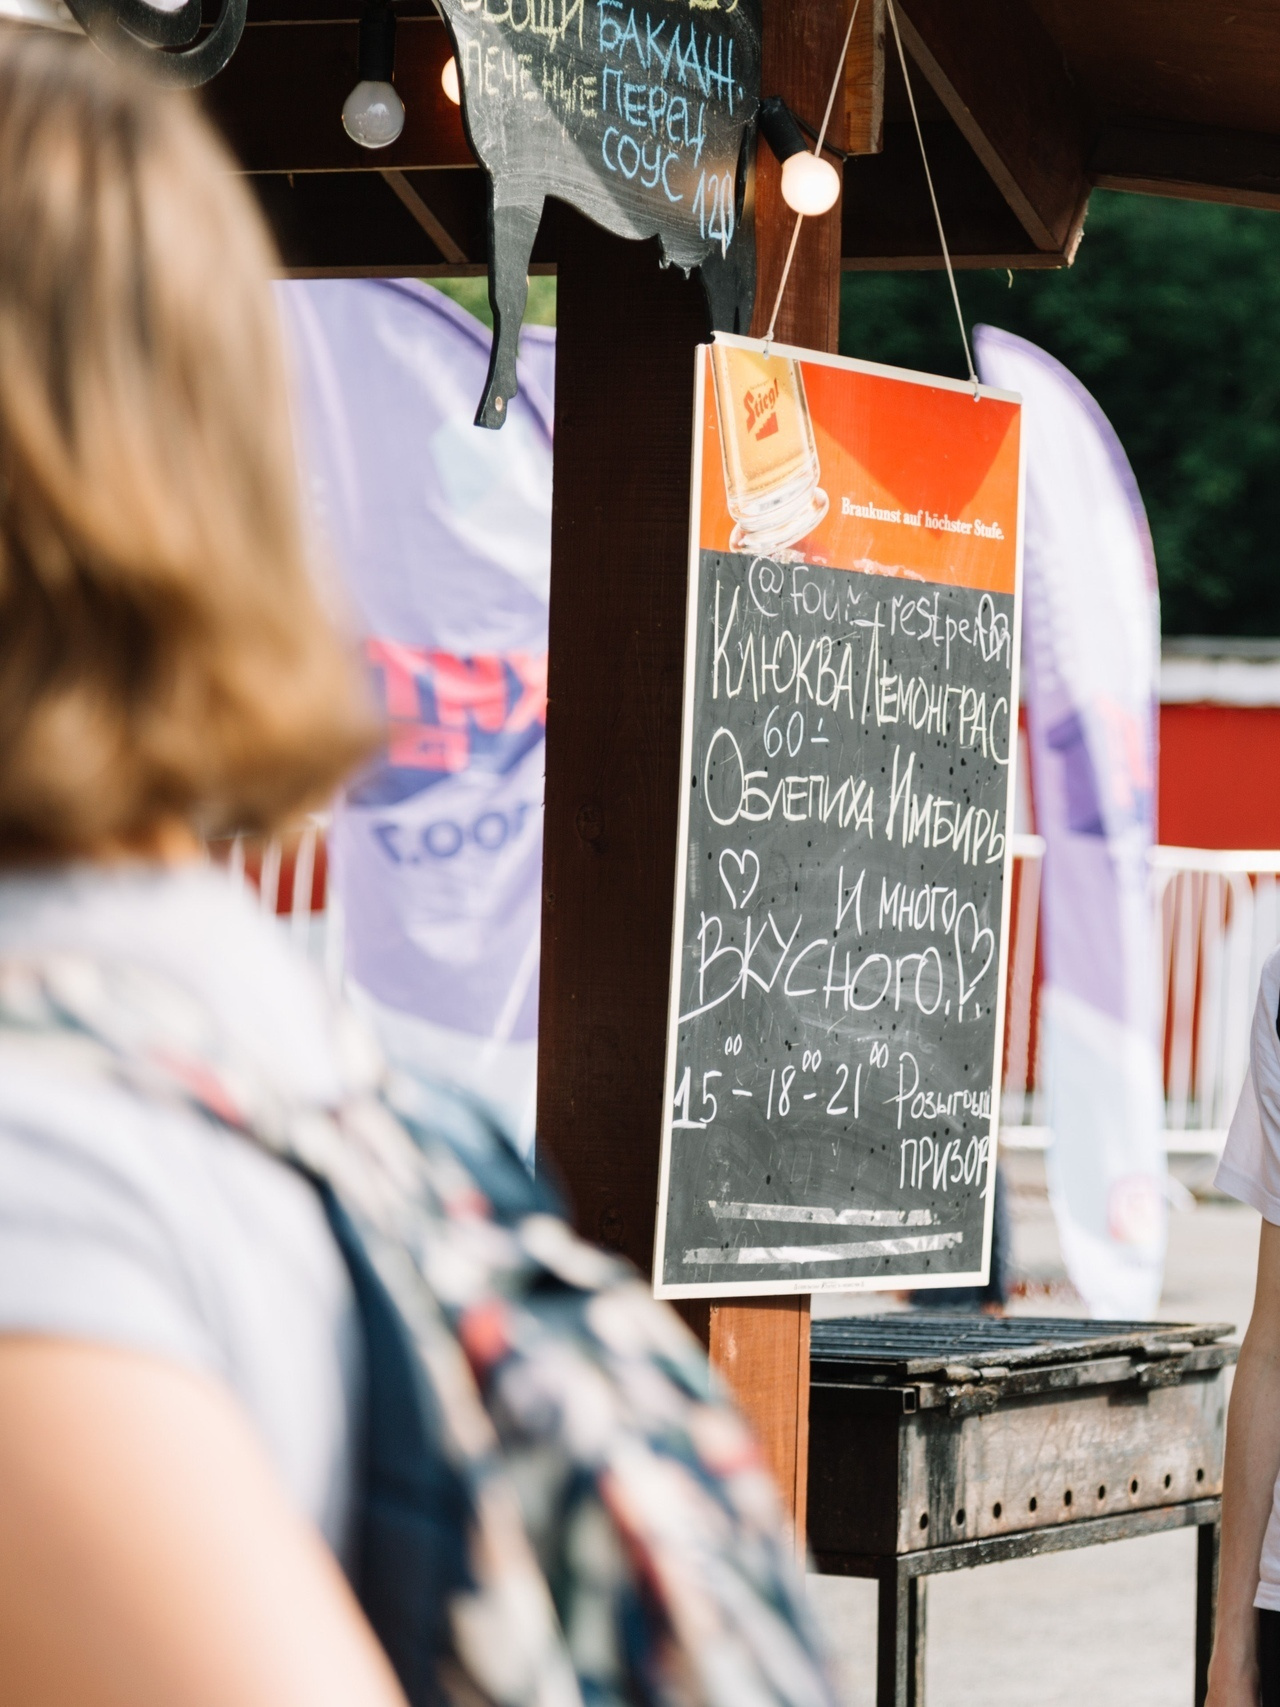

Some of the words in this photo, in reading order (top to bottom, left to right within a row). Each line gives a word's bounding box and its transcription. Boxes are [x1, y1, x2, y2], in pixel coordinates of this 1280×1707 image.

[602, 125, 683, 202] СОУС
[743, 377, 779, 434] Stiegl
[841, 497, 901, 523] Braukunst
[903, 510, 923, 526] auf
[924, 511, 973, 535] höchster
[973, 519, 1004, 540] Stufe.
[835, 866, 866, 935] И
